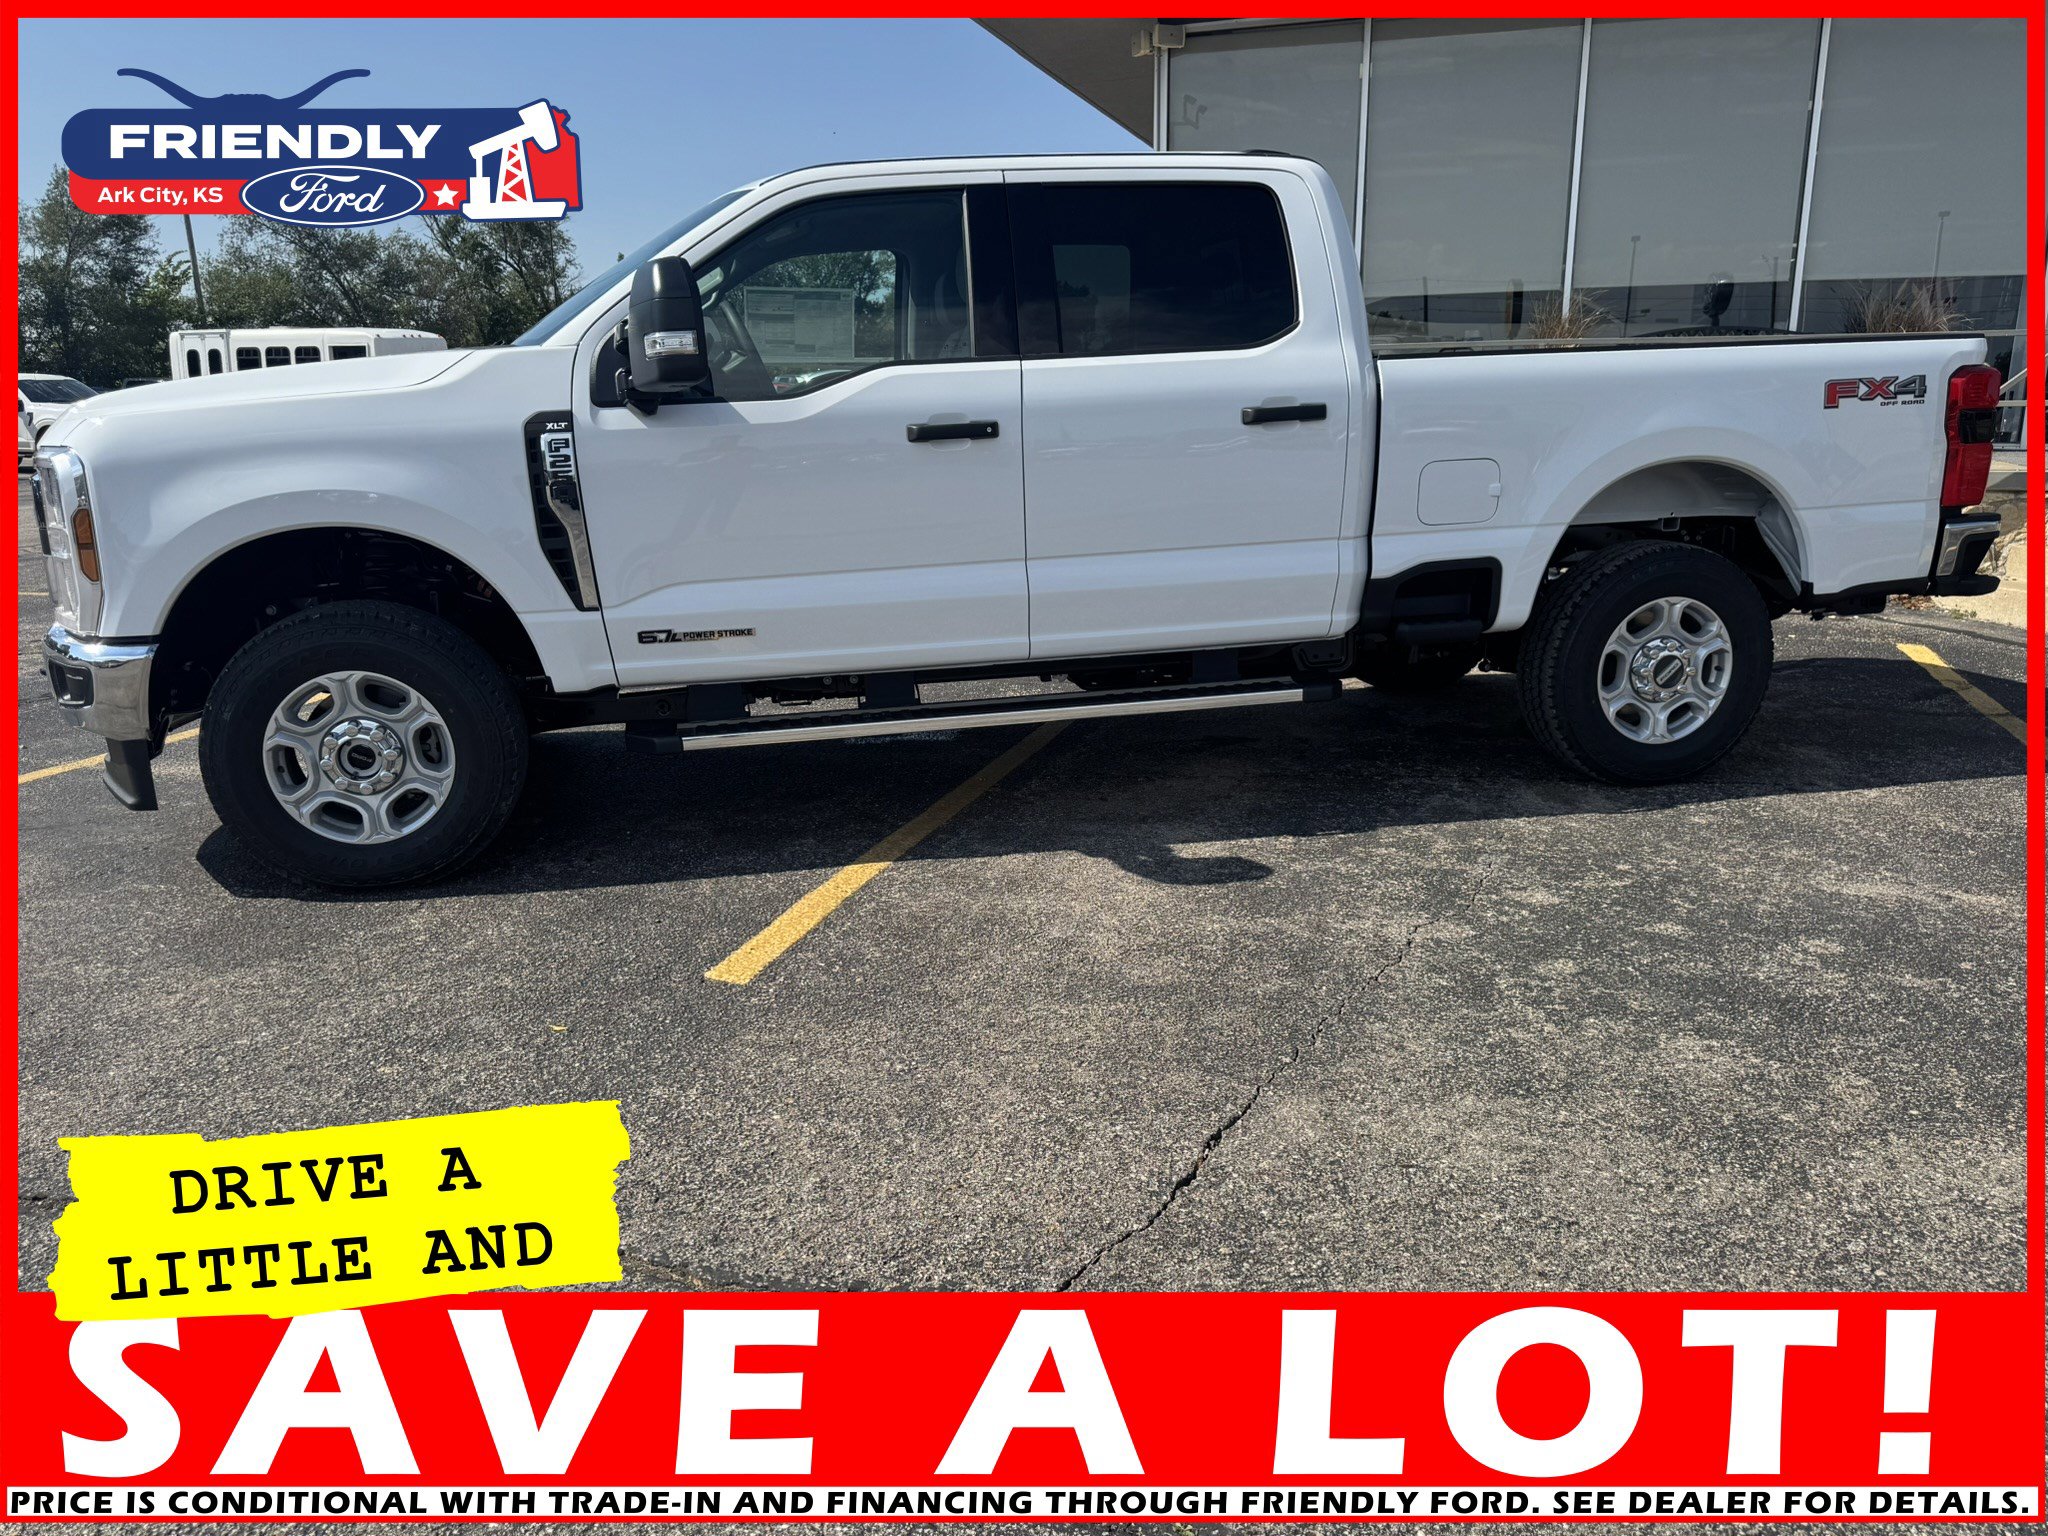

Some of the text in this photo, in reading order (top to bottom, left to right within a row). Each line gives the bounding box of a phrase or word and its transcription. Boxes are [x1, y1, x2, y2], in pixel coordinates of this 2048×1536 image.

[1823, 374, 1927, 409] FX4
[545, 422, 568, 430] XLT
[637, 629, 682, 644] 6.7L
[683, 631, 717, 640] POWER
[717, 627, 753, 637] STROKE
